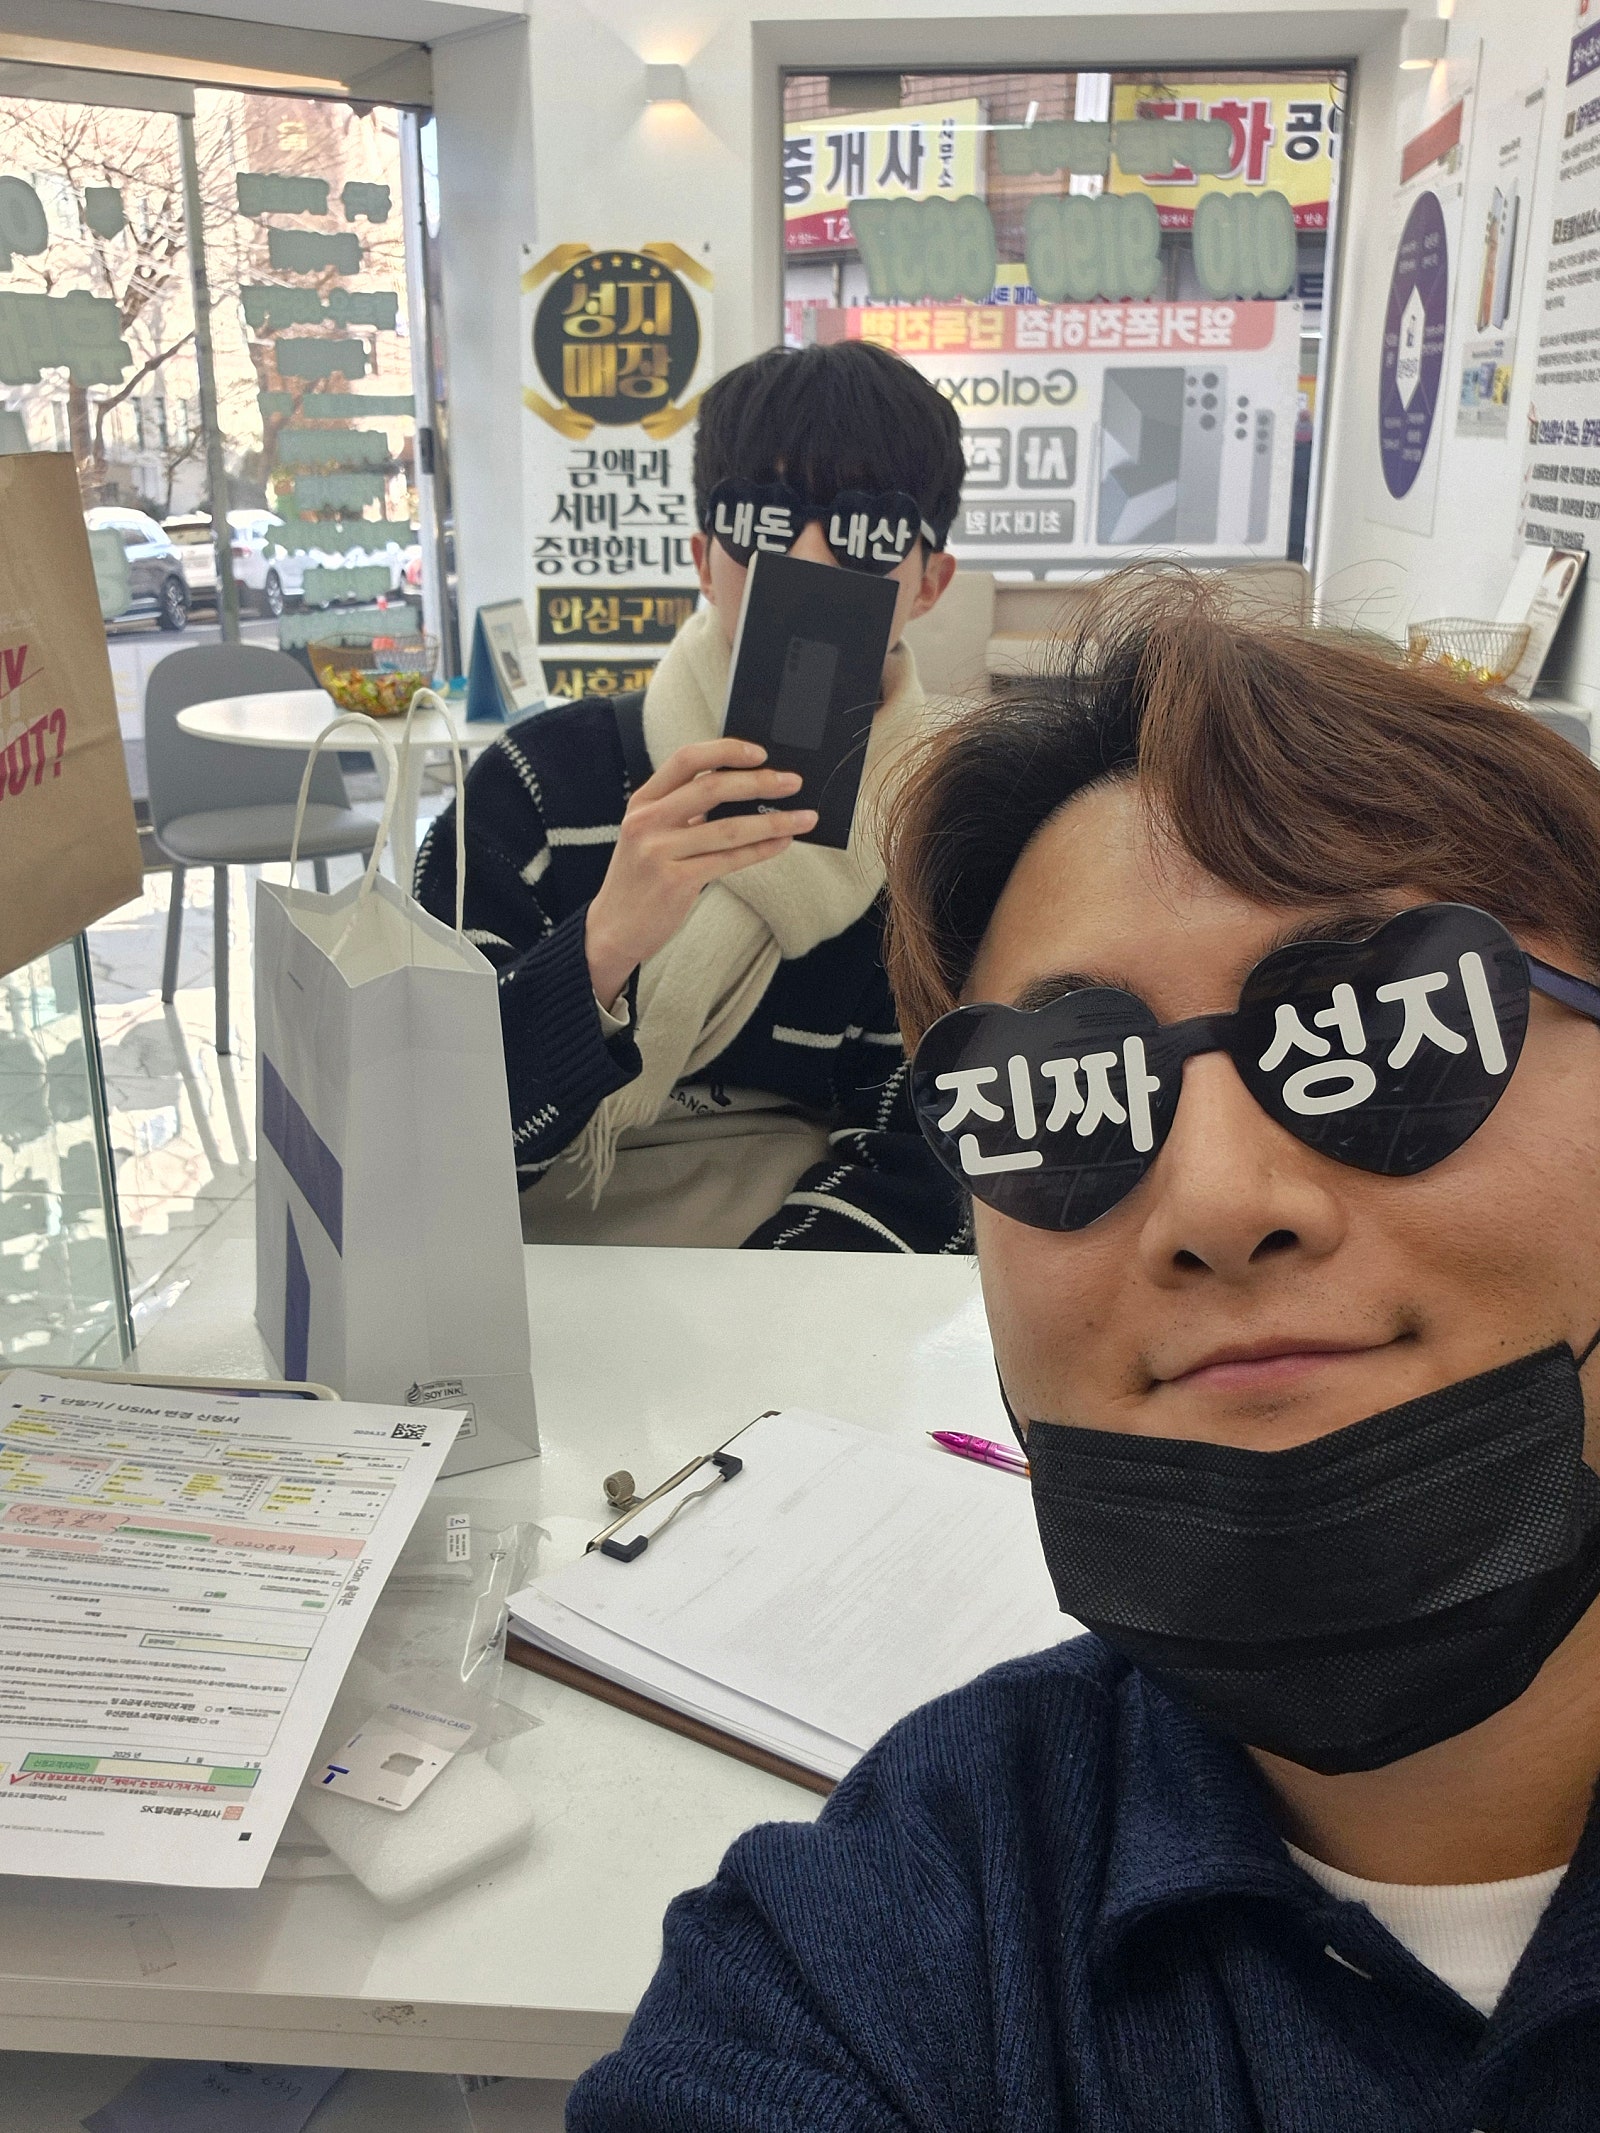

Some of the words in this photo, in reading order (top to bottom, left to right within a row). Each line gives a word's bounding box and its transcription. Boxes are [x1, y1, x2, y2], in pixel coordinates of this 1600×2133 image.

[784, 122, 926, 204] 중개사
[562, 281, 672, 338] 성지
[562, 343, 670, 398] 매장
[567, 448, 670, 487] 금액과
[549, 493, 689, 531] 서비스로
[715, 502, 794, 552] 내돈
[829, 513, 911, 562] 내산
[936, 1036, 1160, 1176] 진짜
[1258, 951, 1508, 1115] 성지
[117, 1404, 160, 1415] USIM
[424, 1390, 443, 1400] SOY
[444, 1387, 461, 1396] INK
[399, 1705, 424, 1718] NANO
[425, 1713, 446, 1725] USIM
[447, 1718, 473, 1731] CARD
[322, 1765, 350, 1784] T
[140, 1805, 221, 1819] SK텔레콤주식회사
